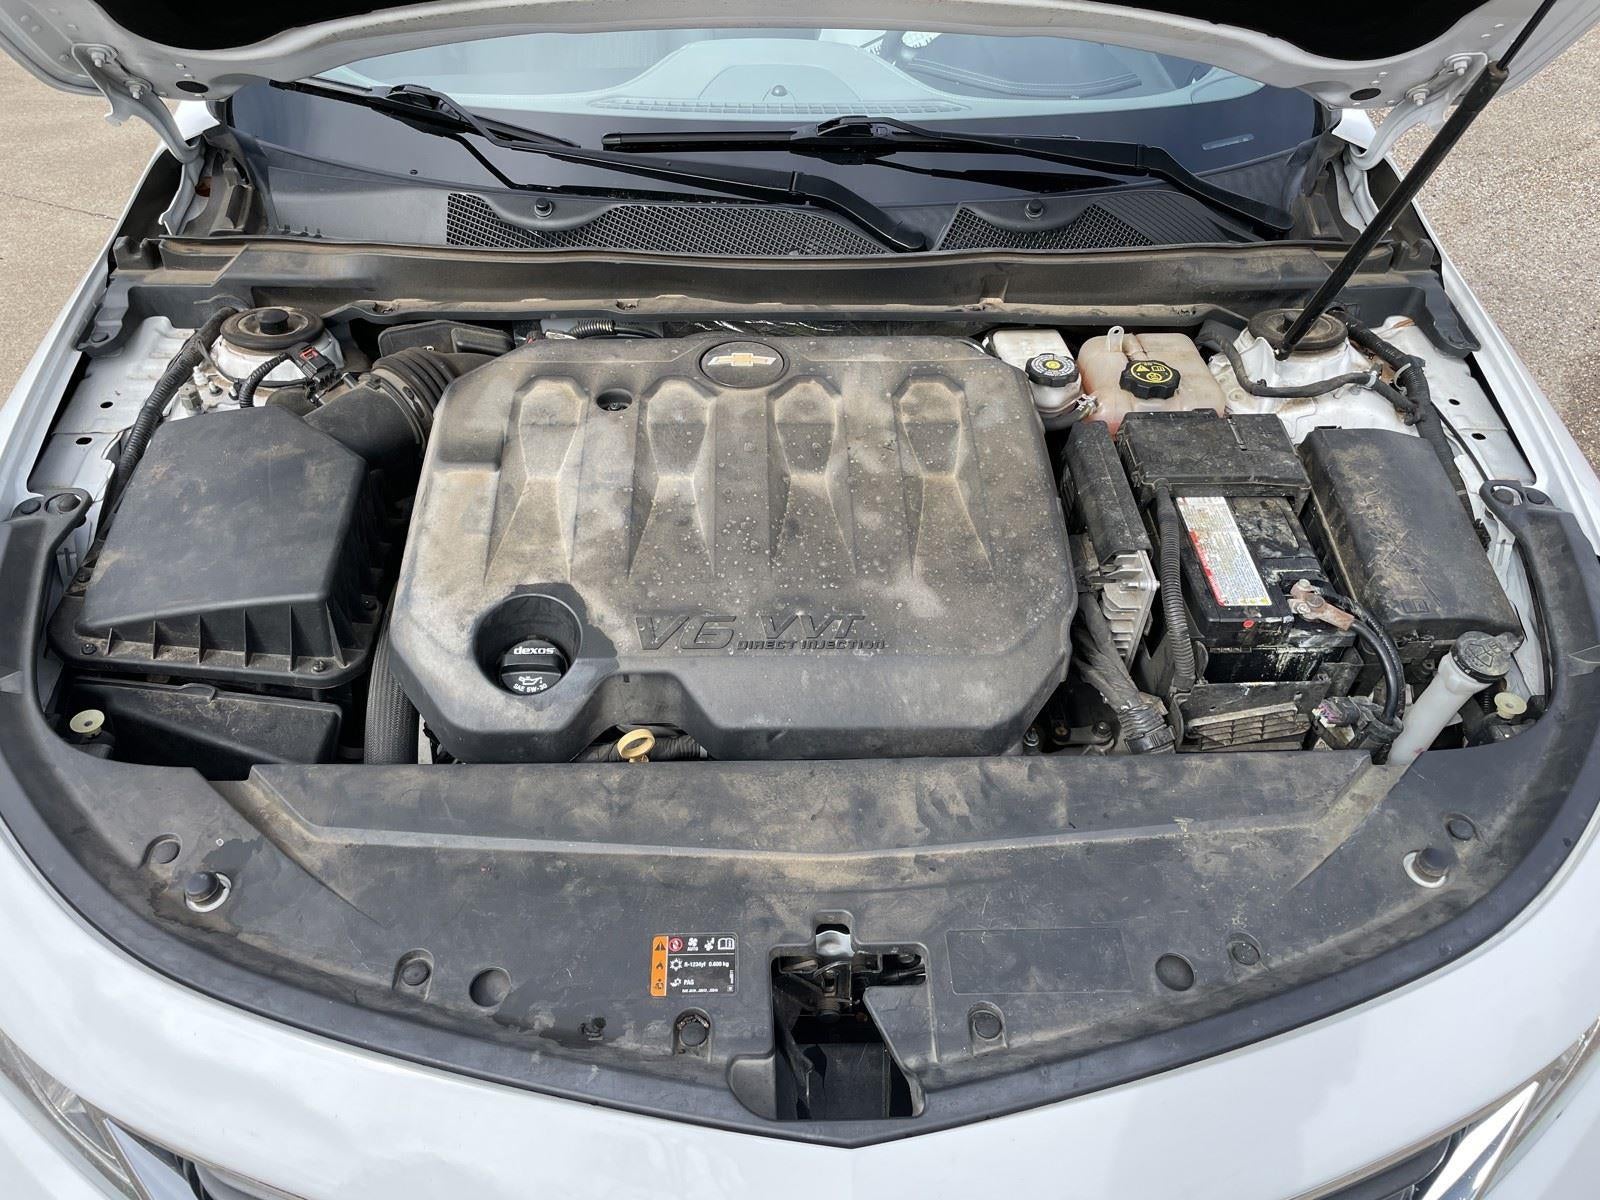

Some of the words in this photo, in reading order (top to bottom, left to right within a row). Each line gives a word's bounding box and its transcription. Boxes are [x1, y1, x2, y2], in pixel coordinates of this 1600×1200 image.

[635, 615, 737, 650] V6
[759, 614, 866, 639] VVT
[737, 640, 798, 650] DIRECT
[801, 640, 886, 650] INJECTION
[513, 646, 556, 655] dexos
[513, 683, 525, 692] SAE
[526, 683, 548, 693] 5W-30
